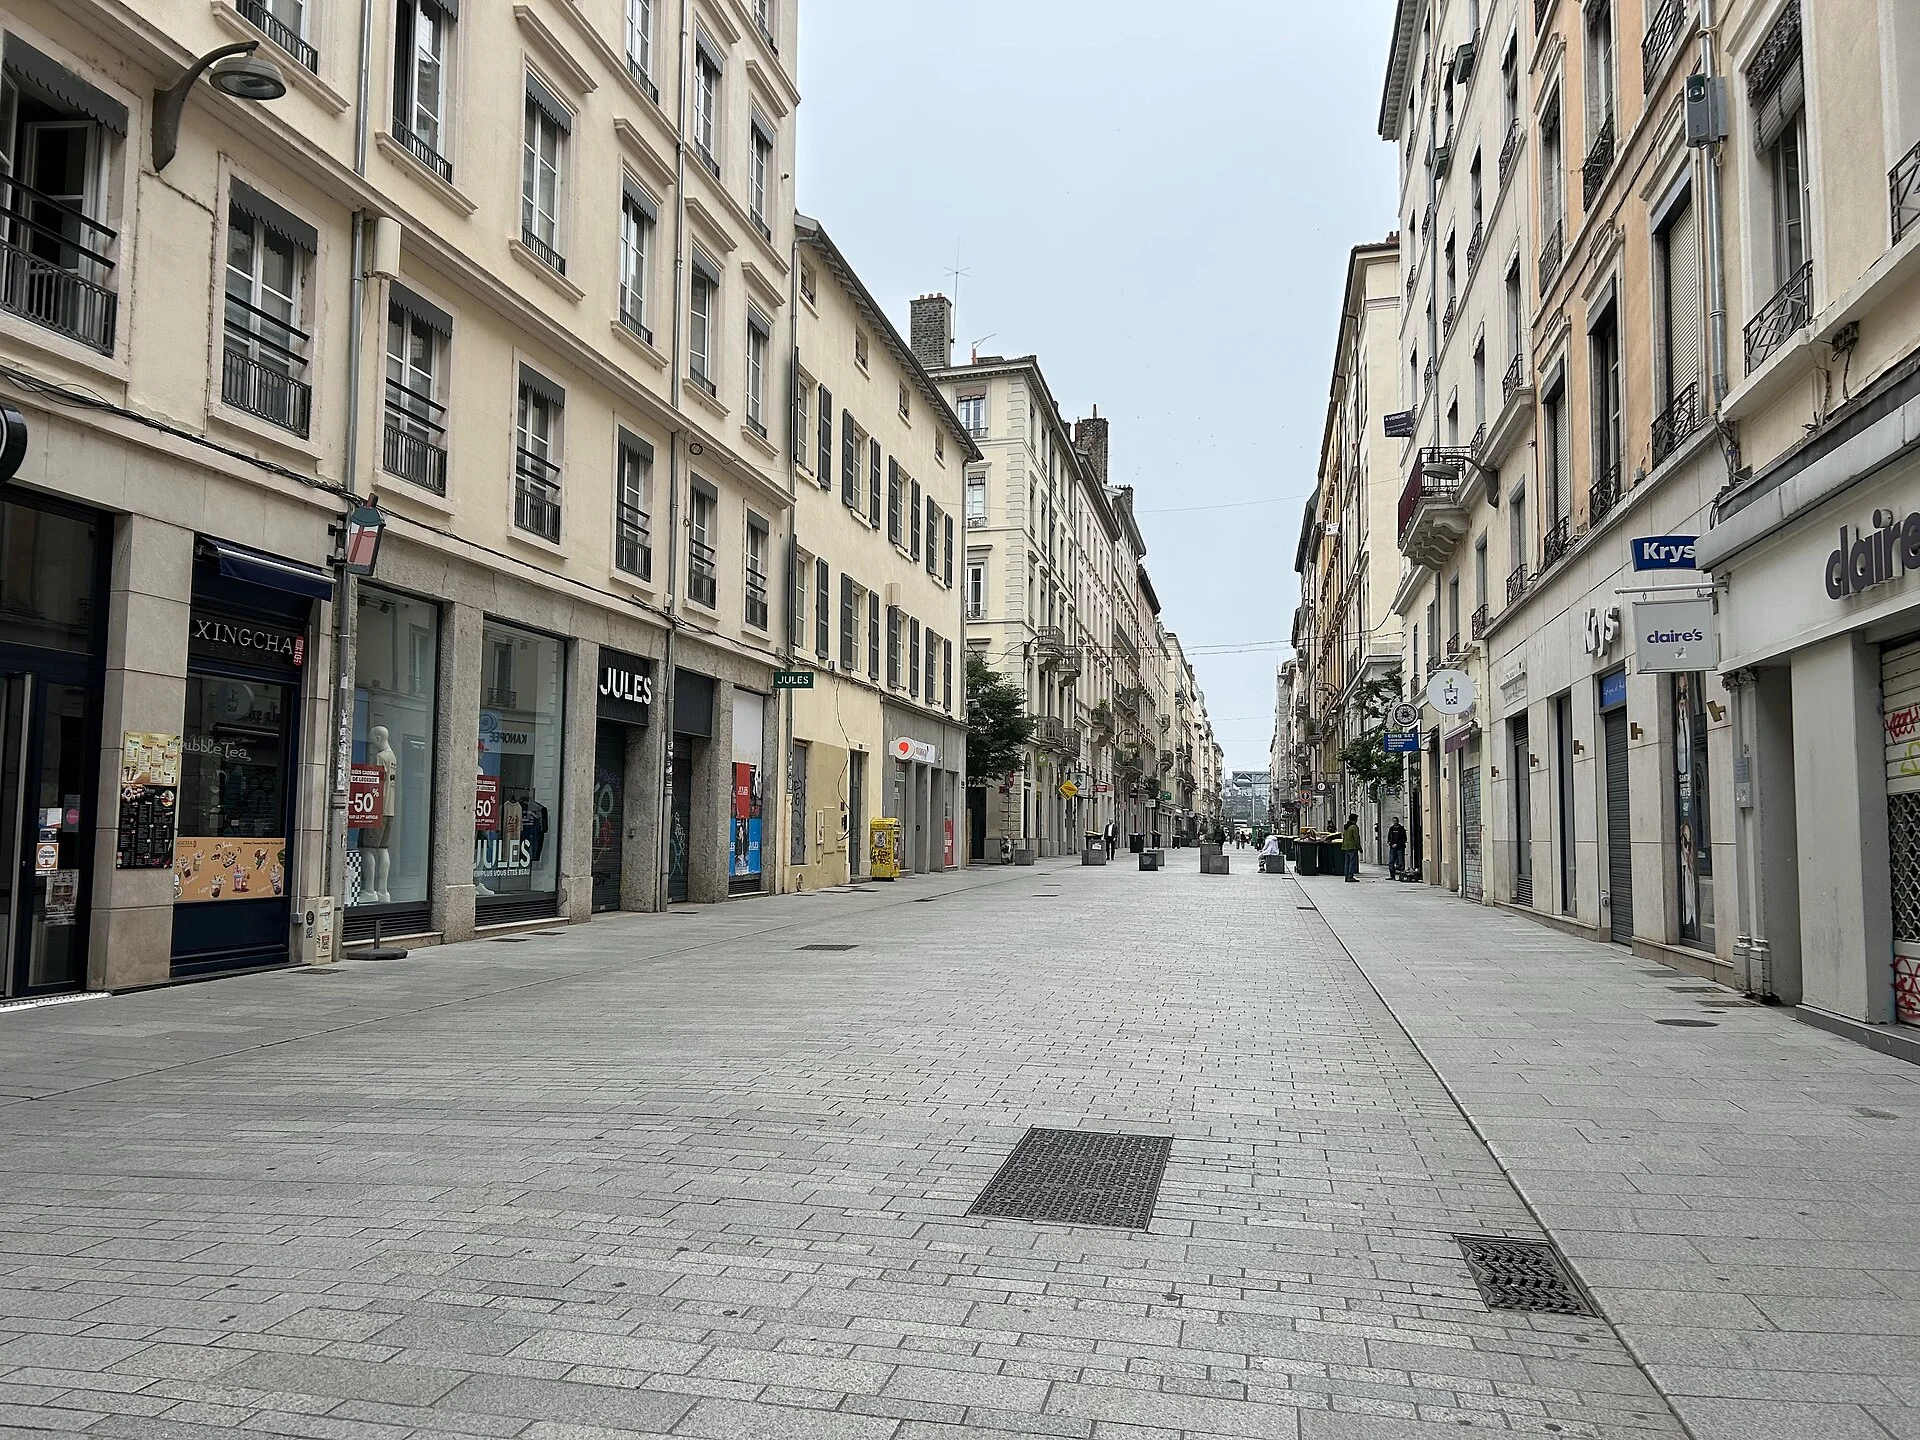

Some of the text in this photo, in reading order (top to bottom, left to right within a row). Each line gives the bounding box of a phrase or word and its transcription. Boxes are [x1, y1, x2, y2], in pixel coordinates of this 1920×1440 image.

[1643, 542, 1696, 563] Krys
[191, 619, 293, 655] XINGCHA
[1646, 628, 1703, 644] claire's
[599, 667, 652, 705] JULES
[777, 675, 809, 685] JULES
[181, 737, 252, 762] ubble Tea
[476, 838, 531, 869] JULES
[493, 869, 507, 877] VOUS
